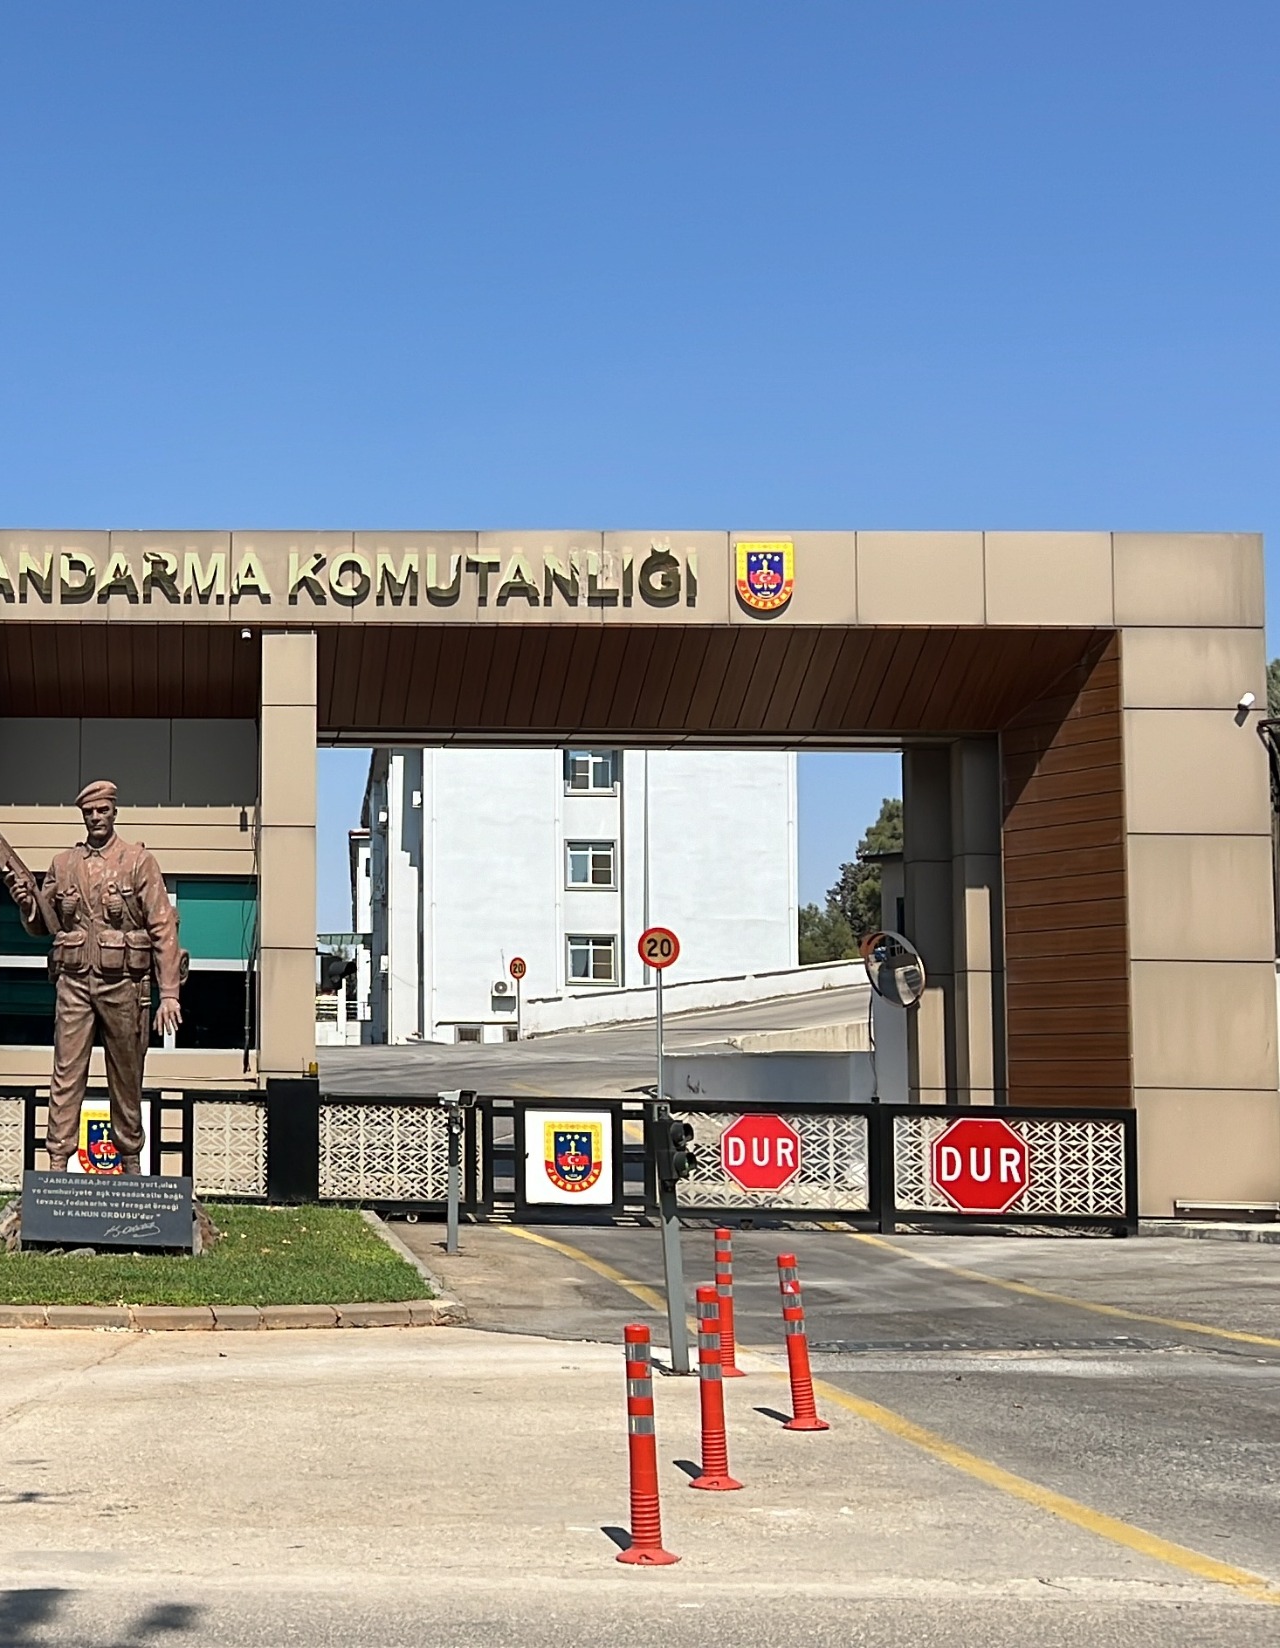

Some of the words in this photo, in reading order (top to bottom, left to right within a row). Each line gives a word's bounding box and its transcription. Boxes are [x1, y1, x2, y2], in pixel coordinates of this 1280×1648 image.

[288, 537, 698, 607] KOMUTANLIĞI
[646, 937, 671, 957] 20
[513, 963, 524, 974] 20
[728, 1137, 795, 1167] DUR
[941, 1146, 1022, 1183] DUR
[42, 1188, 93, 1197] cumhuriyete
[96, 1190, 110, 1198] aşk
[121, 1191, 162, 1199] sadakatle
[163, 1192, 184, 1201] bağlı
[53, 1209, 65, 1217] bir
[67, 1210, 99, 1218] KANUN
[121, 1201, 152, 1210] feragat
[153, 1202, 179, 1212] örneği
